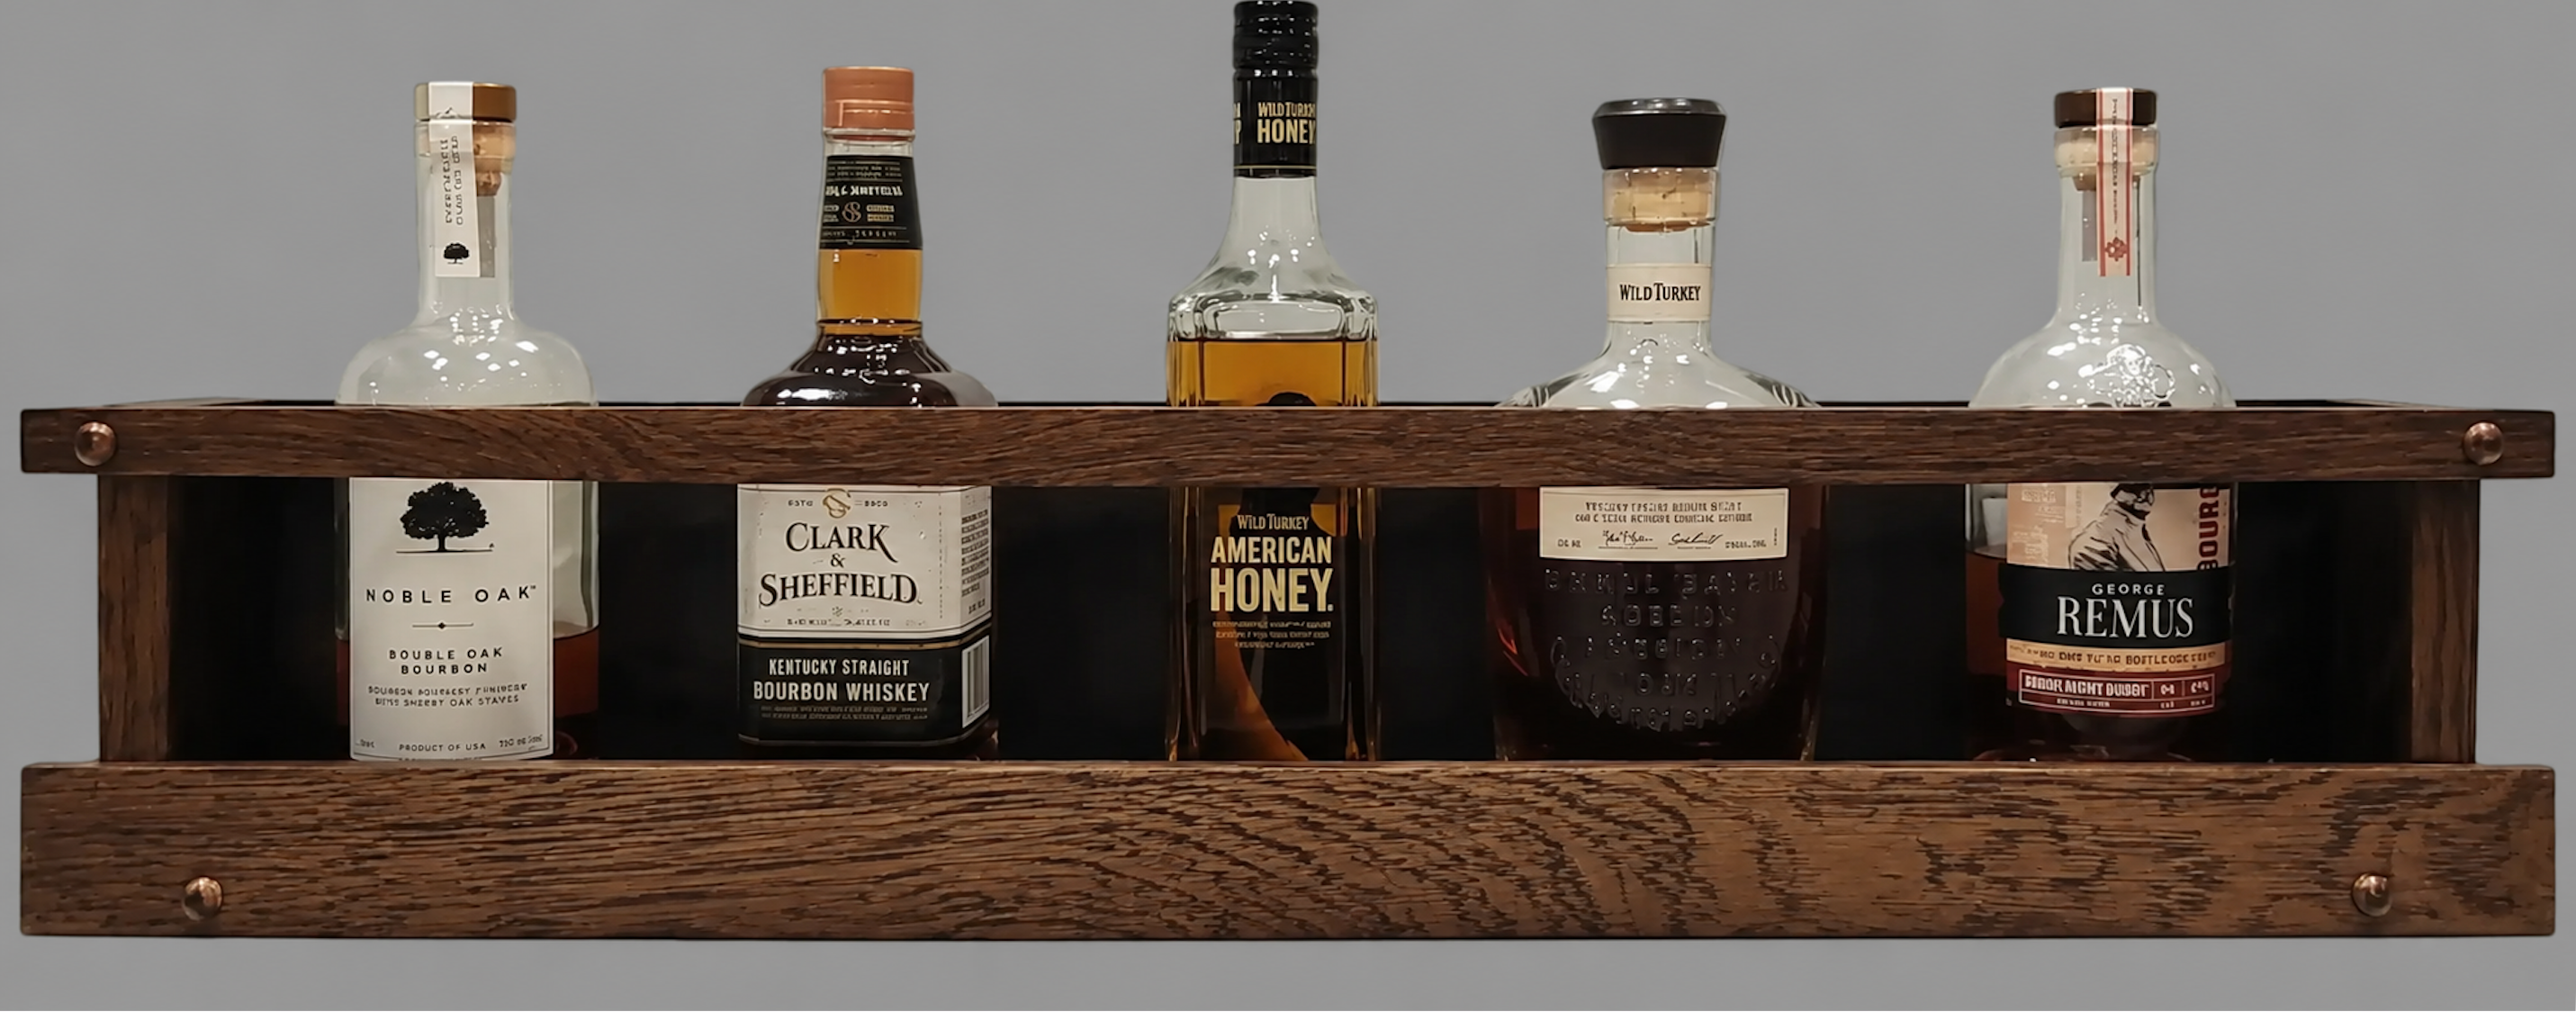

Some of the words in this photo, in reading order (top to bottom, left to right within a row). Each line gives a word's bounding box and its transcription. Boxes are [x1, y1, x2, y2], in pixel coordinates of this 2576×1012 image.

[1258, 102, 1284, 117] WILD
[1619, 284, 1653, 301] WILD
[1653, 283, 1701, 302] TURKEY
[1237, 514, 1265, 529] WILD
[1266, 513, 1309, 530] TURKEY
[786, 522, 898, 563] CLARK
[1211, 537, 1332, 564] AMERICAN
[831, 553, 846, 568] &
[365, 588, 452, 603] NOBLE
[2092, 583, 2165, 596] GEORGE
[2057, 595, 2193, 638] REMUS
[467, 647, 502, 659] OAK
[401, 663, 488, 675] BOURBON
[770, 659, 837, 675] KENTUCKY
[842, 659, 909, 676] STRAIGHT
[753, 682, 838, 700] BOURBON
[846, 682, 929, 701] WHISKEY
[450, 699, 473, 707] OAK
[399, 743, 443, 752] PRODUCT
[448, 743, 460, 751] OF
[465, 742, 486, 751] USA
